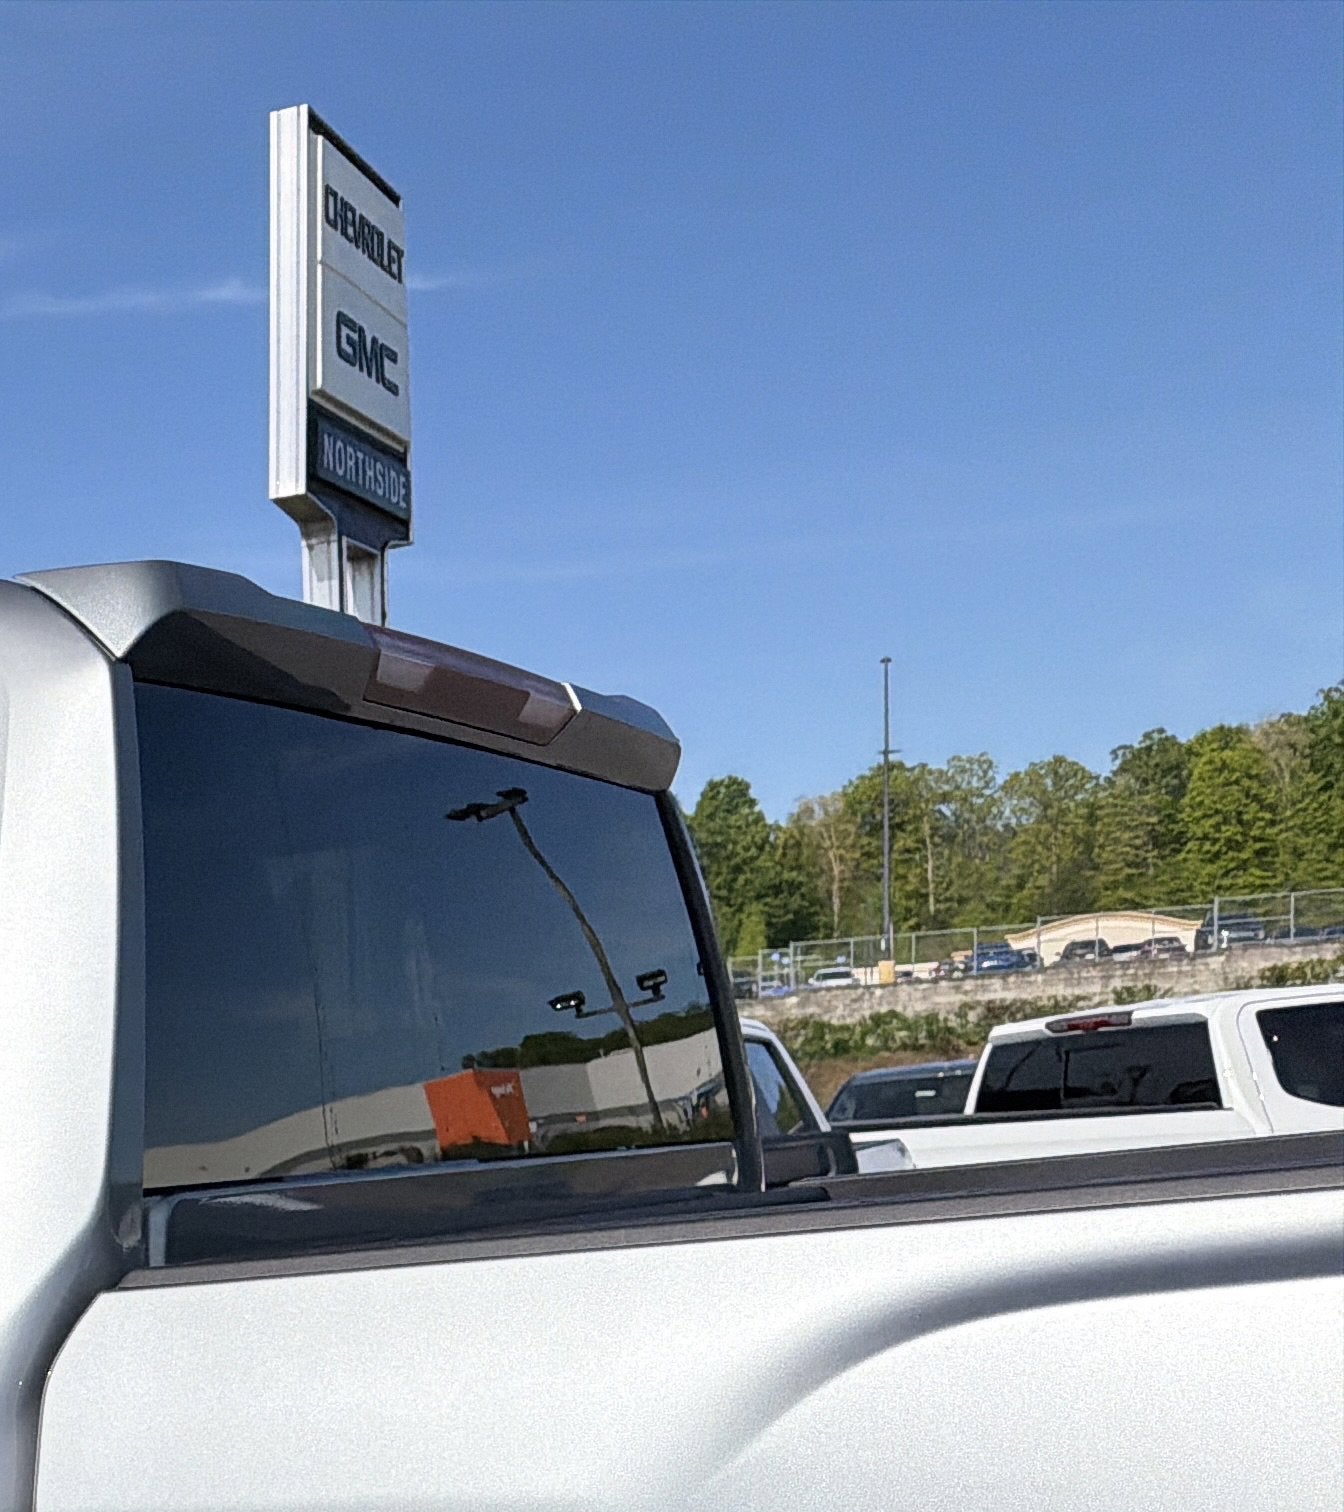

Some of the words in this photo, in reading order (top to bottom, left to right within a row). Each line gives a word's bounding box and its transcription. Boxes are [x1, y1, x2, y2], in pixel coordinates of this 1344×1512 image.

[324, 183, 404, 285] CHEVROLET
[335, 309, 399, 397] GMC
[322, 432, 407, 509] NORTHSIDE
